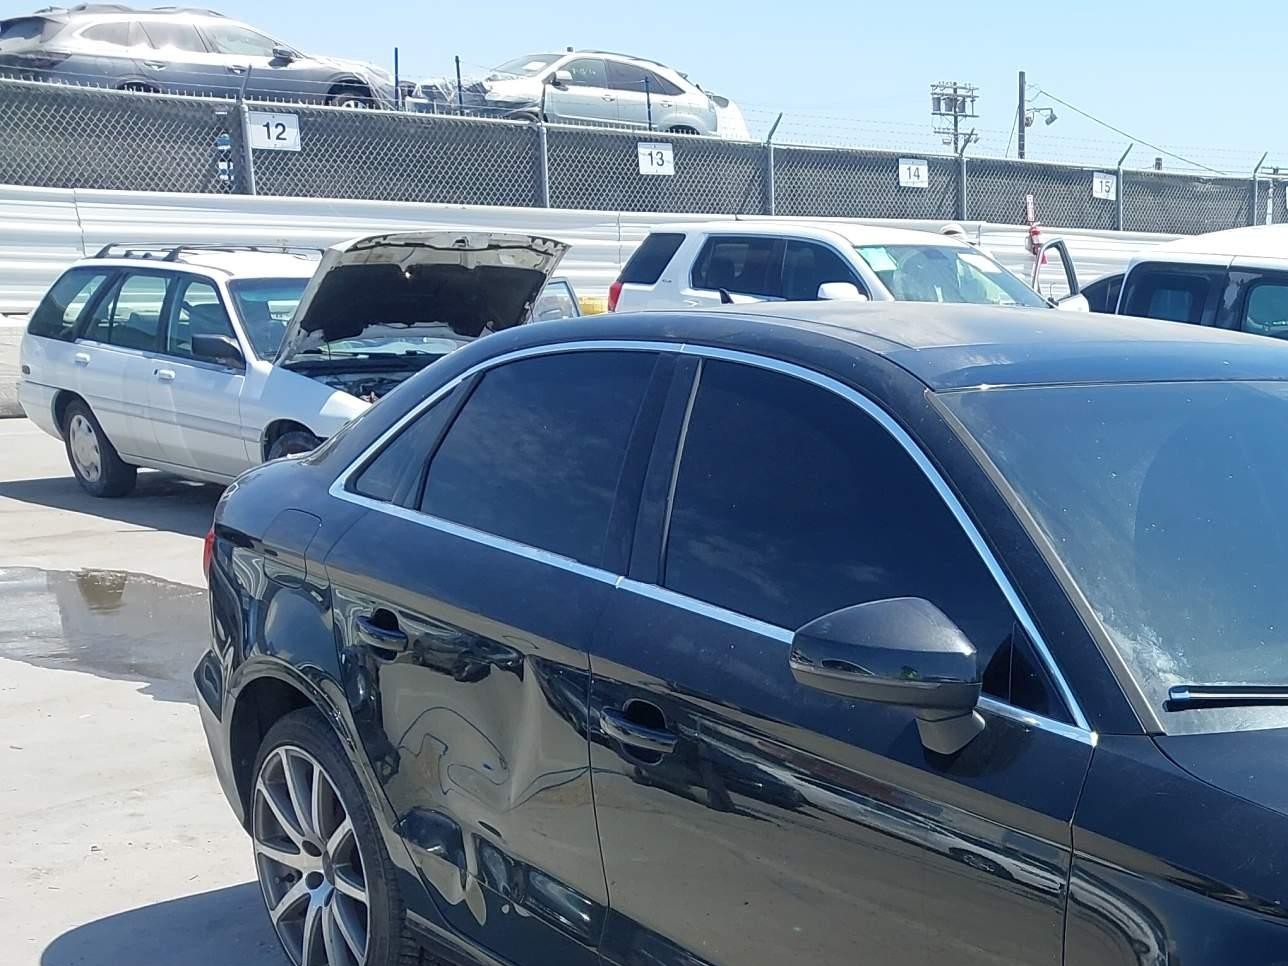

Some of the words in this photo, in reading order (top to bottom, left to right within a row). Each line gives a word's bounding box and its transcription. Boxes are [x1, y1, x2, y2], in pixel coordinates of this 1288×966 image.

[262, 121, 288, 141] 12
[647, 150, 665, 167] 13
[906, 165, 921, 180] 14
[1099, 180, 1111, 194] 15
